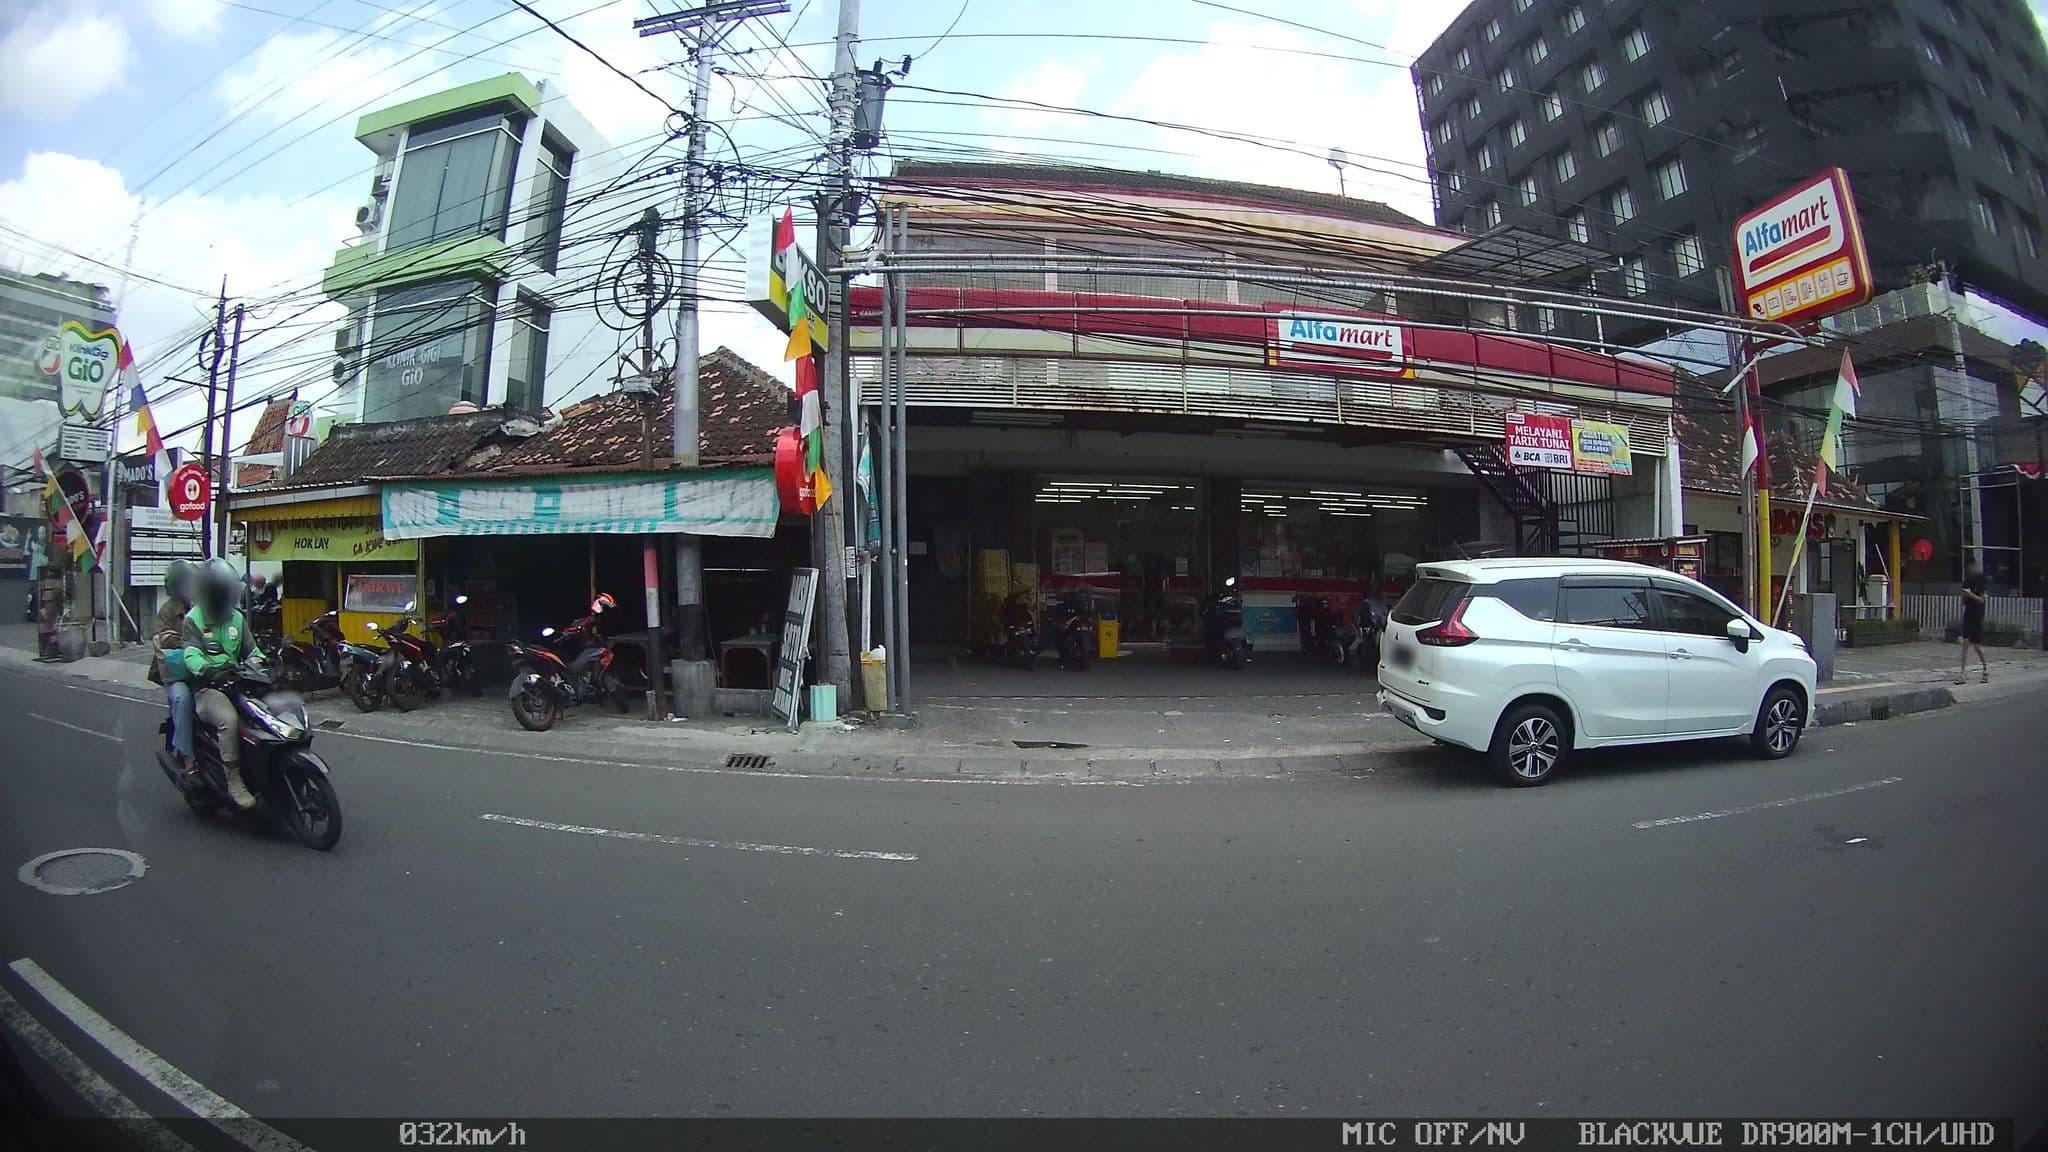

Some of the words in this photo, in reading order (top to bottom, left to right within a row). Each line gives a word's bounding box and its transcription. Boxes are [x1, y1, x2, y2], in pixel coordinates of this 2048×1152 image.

[1745, 195, 1830, 257] Alfamart
[1290, 319, 1393, 348] Alfamart
[1515, 425, 1563, 439] MELAYANI
[1508, 435, 1538, 448] TARIK
[1541, 439, 1570, 450] TUNAI
[1523, 451, 1541, 462] BCA
[1553, 454, 1568, 465] BRI
[180, 502, 206, 513] gofood
